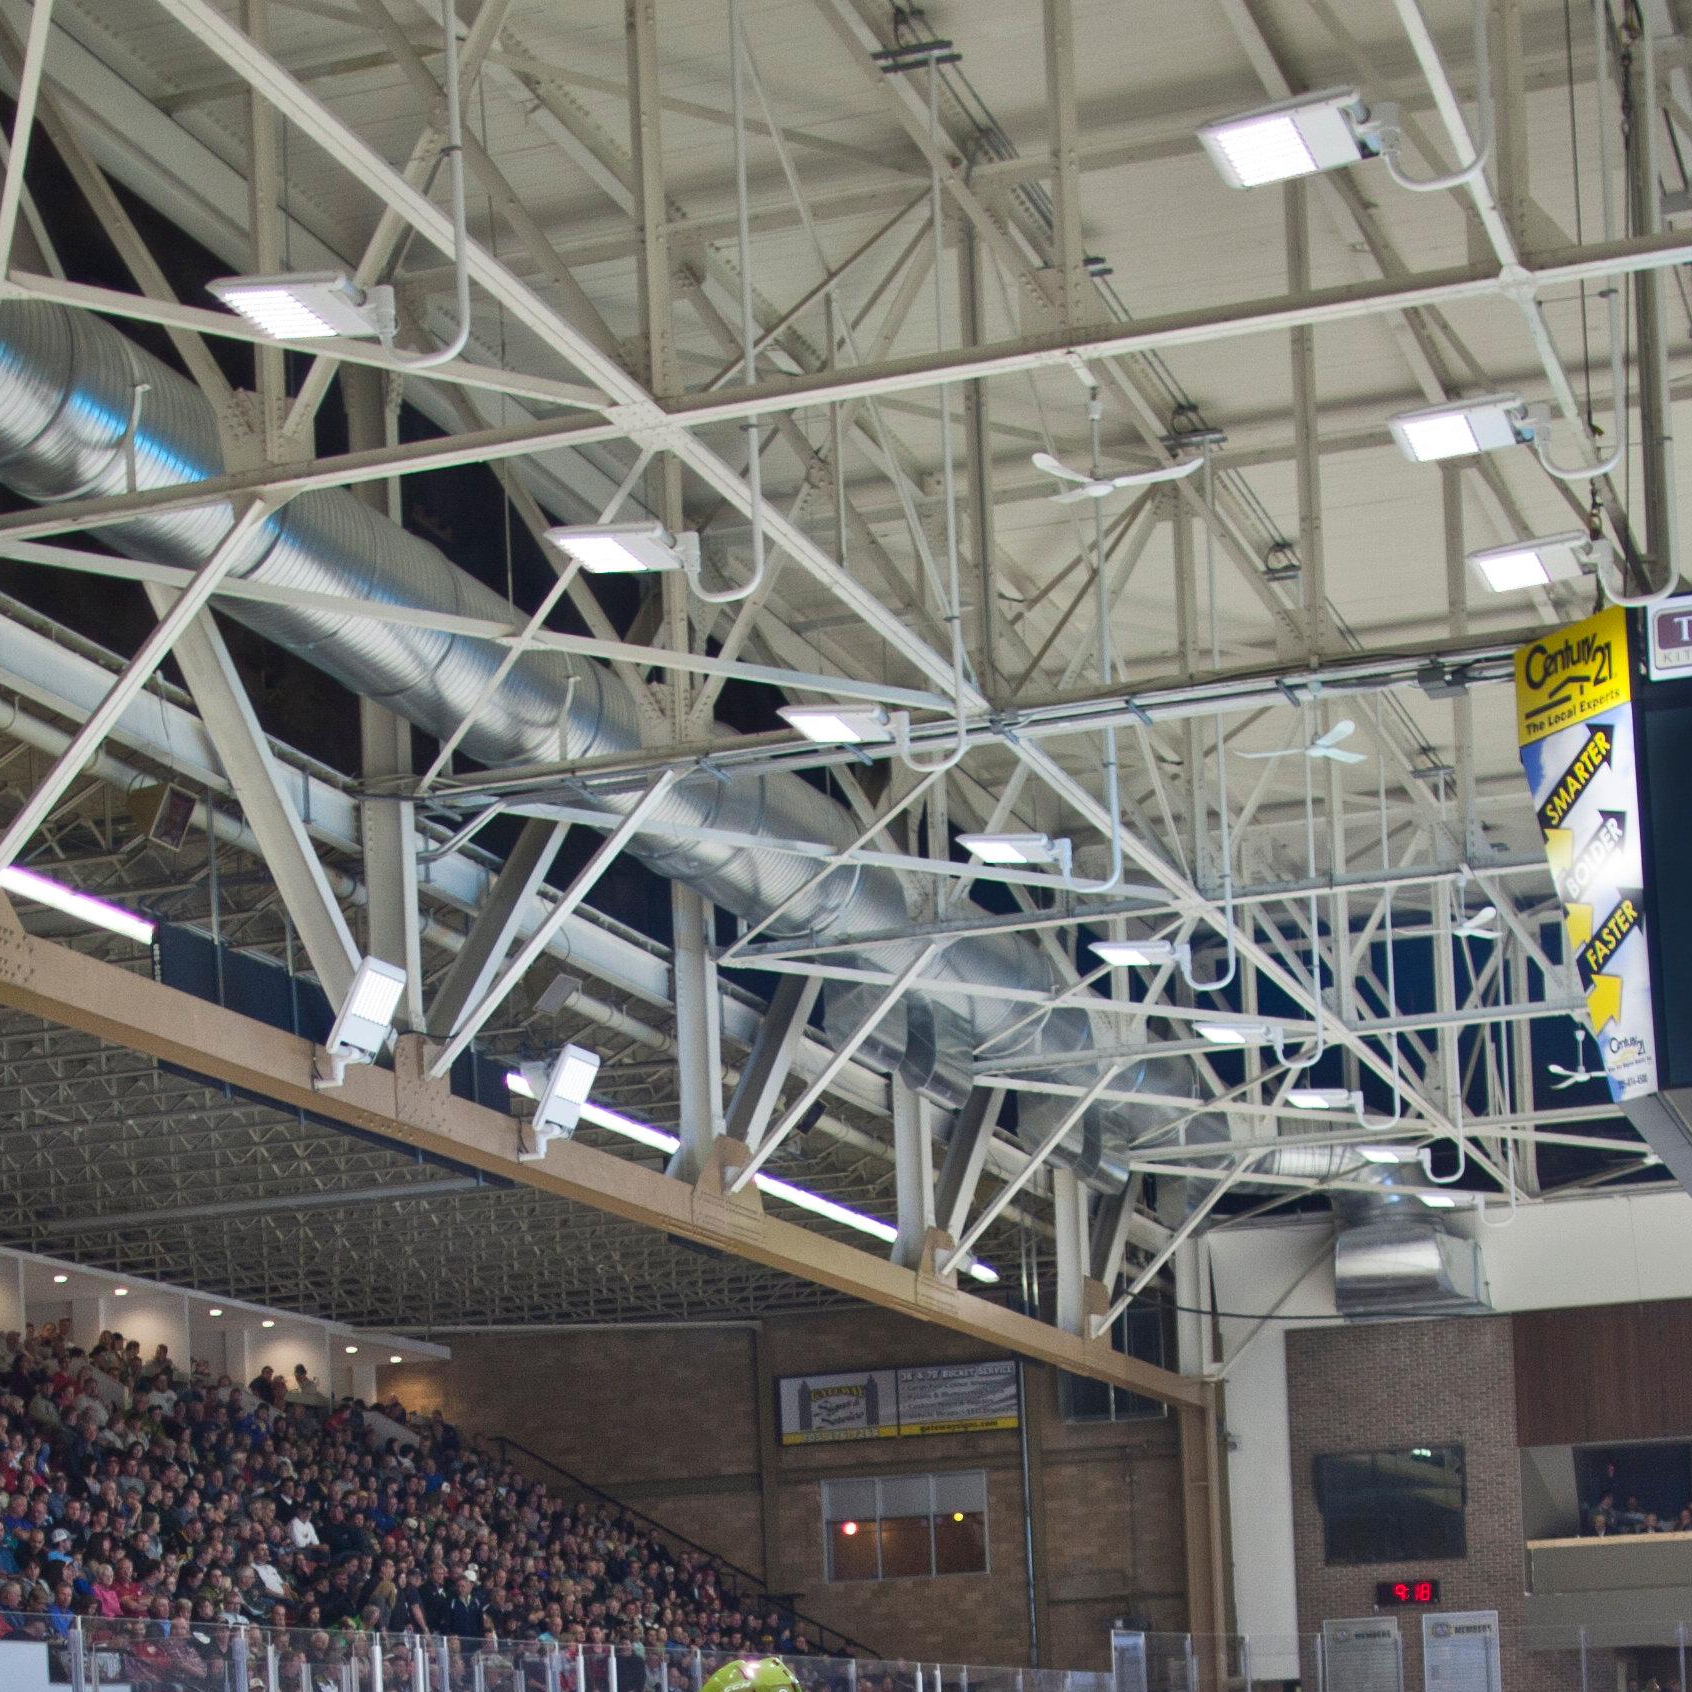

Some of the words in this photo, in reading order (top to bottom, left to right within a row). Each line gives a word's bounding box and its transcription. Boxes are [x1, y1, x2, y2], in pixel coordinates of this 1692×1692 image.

[1526, 633, 1598, 690] Century
[1592, 640, 1614, 687] 21
[1526, 719, 1546, 736] The
[1547, 709, 1577, 727] Local
[1580, 687, 1621, 714] Experts
[1545, 731, 1611, 827] SMARTER
[1566, 817, 1623, 900] BOLDER
[1586, 899, 1638, 972] FASTER
[1395, 1582, 1432, 1602] 9:18
